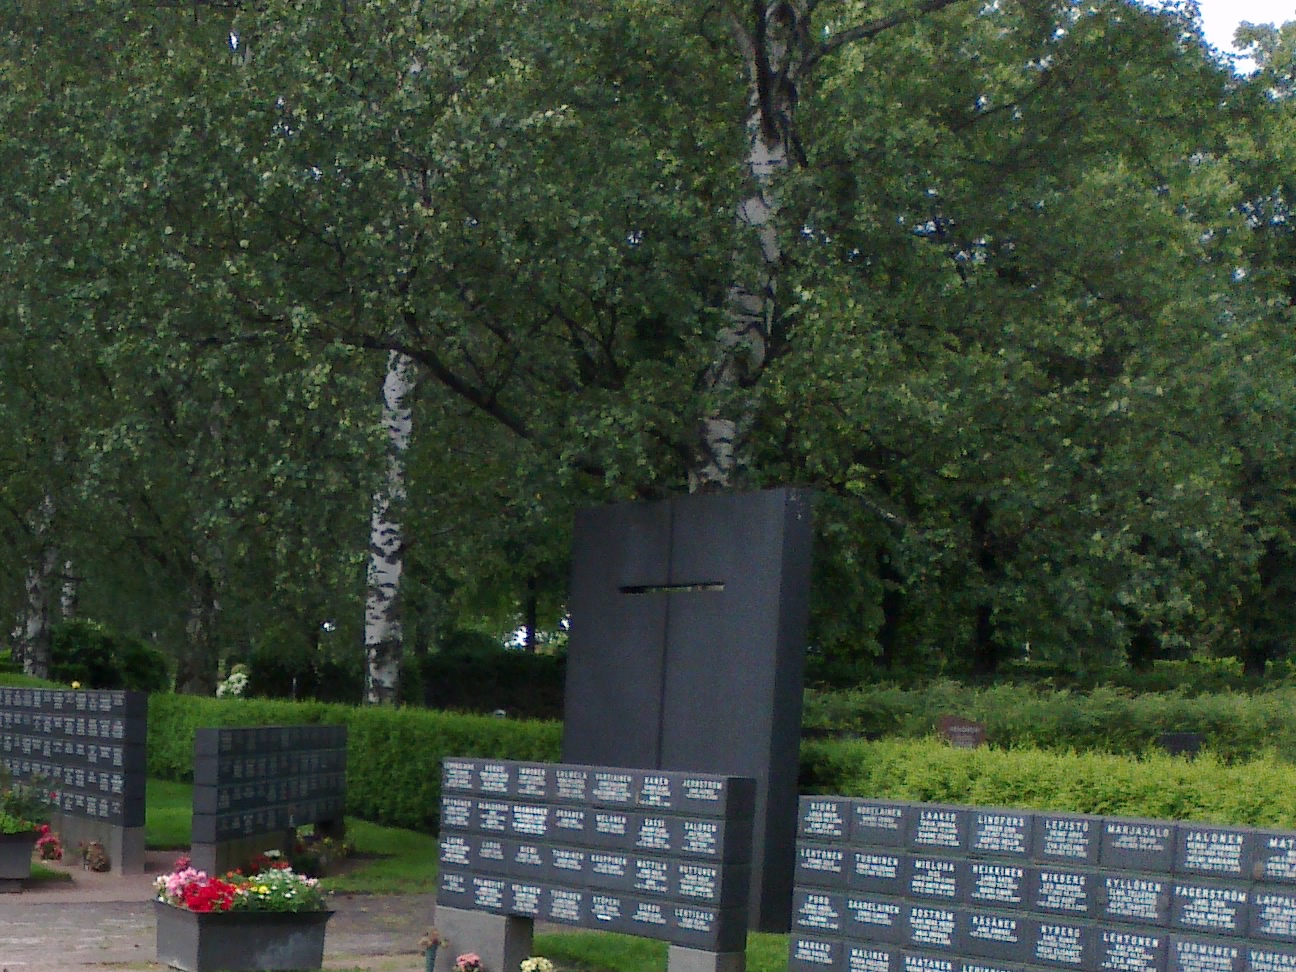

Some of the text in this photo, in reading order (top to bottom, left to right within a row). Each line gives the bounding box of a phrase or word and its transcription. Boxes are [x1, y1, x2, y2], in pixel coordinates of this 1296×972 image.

[920, 811, 956, 822] LAAKSO
[978, 814, 1025, 827] LINDFORS
[1107, 824, 1170, 838] MARJASALO
[1187, 832, 1244, 845] JALONEN
[972, 864, 1023, 878] HEIKKINEN
[1106, 878, 1162, 893] KYLLÖNEN
[1175, 886, 1247, 902] FAGERSTRÖM
[1103, 932, 1160, 948] LEHTONEN
[1177, 942, 1238, 958] SORMUNEN
